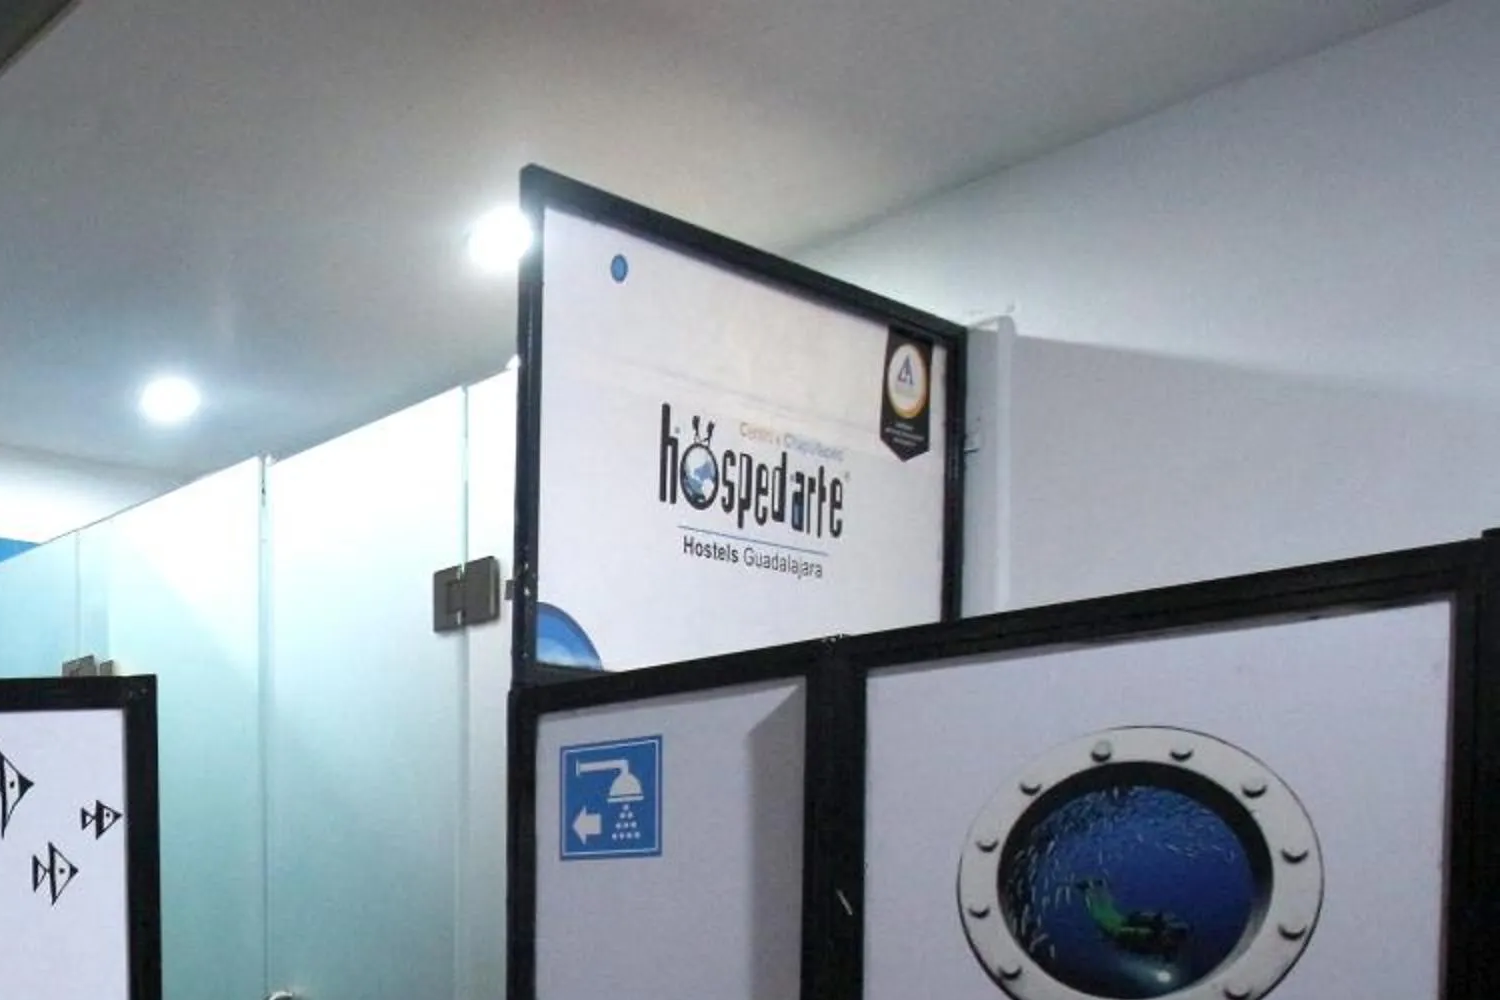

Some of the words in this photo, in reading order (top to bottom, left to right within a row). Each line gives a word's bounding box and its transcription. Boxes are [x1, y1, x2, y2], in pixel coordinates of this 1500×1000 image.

[659, 402, 844, 539] hospedarte
[682, 534, 740, 564] Hostels
[742, 547, 824, 579] Guadalajara
